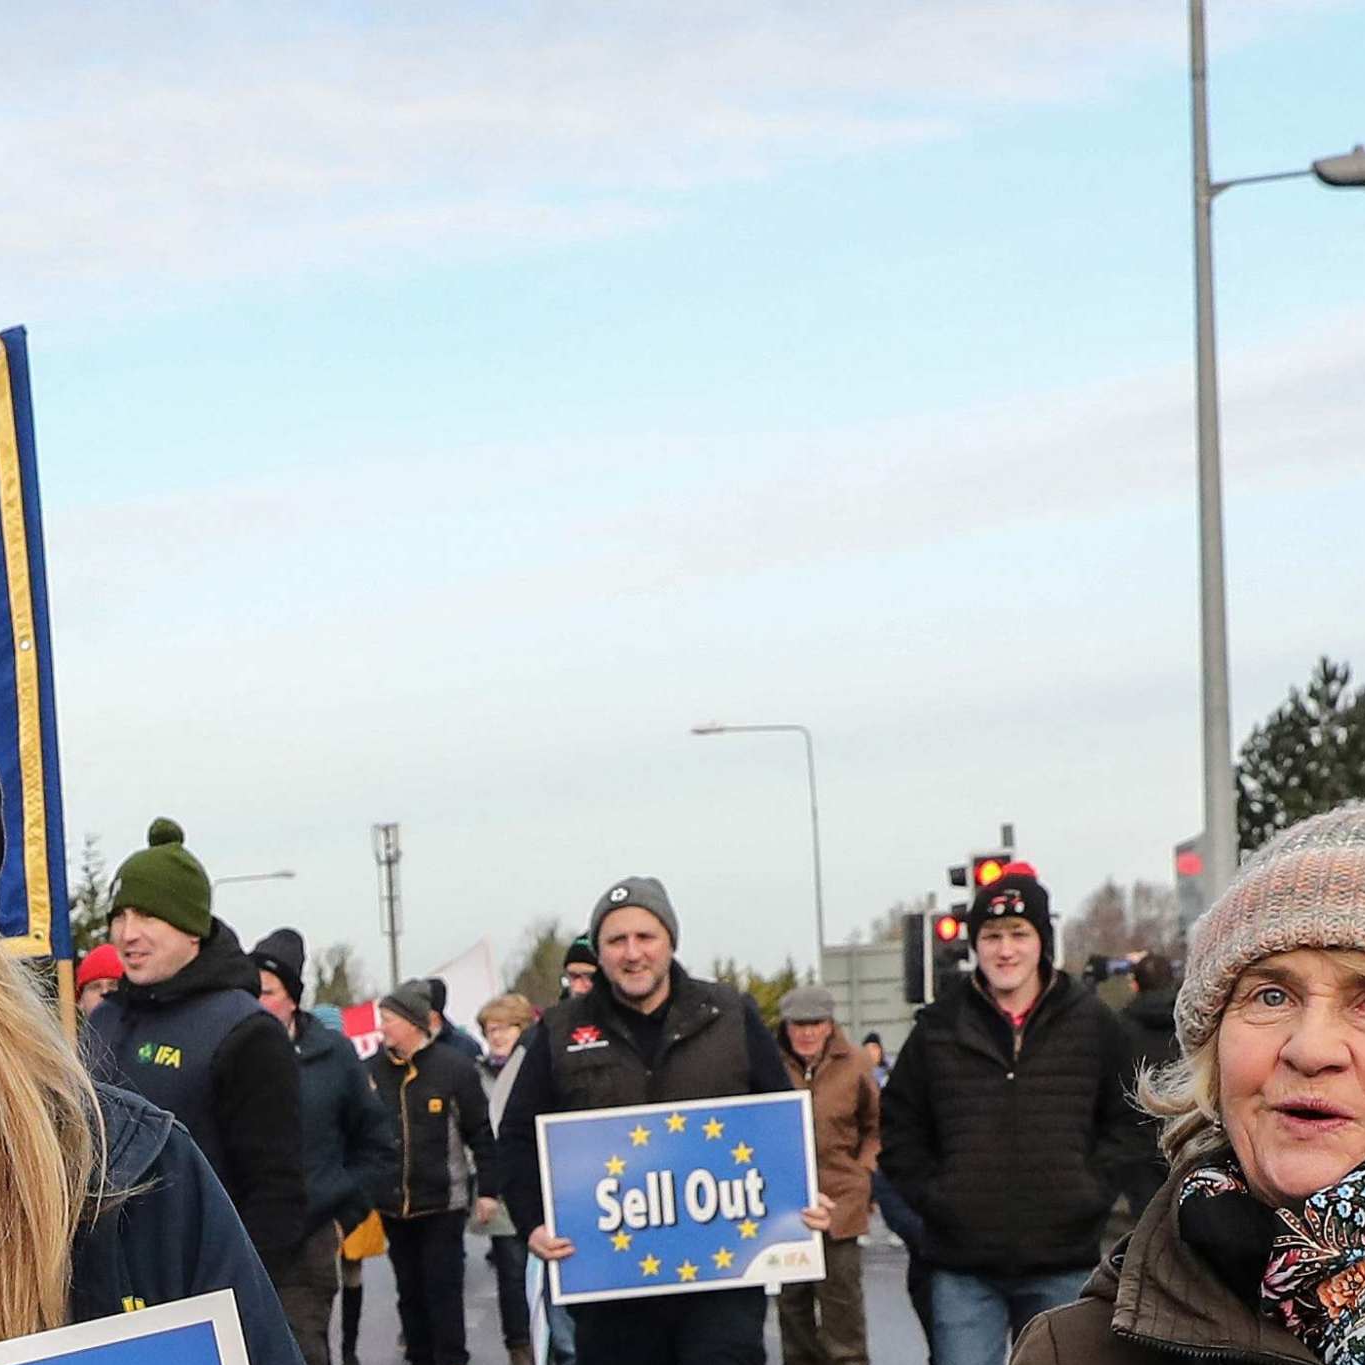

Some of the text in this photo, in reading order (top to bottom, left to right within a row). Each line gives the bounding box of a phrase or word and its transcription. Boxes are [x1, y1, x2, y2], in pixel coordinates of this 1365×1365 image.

[154, 1045, 181, 1069] IFA
[595, 1168, 766, 1232] Sell Out
